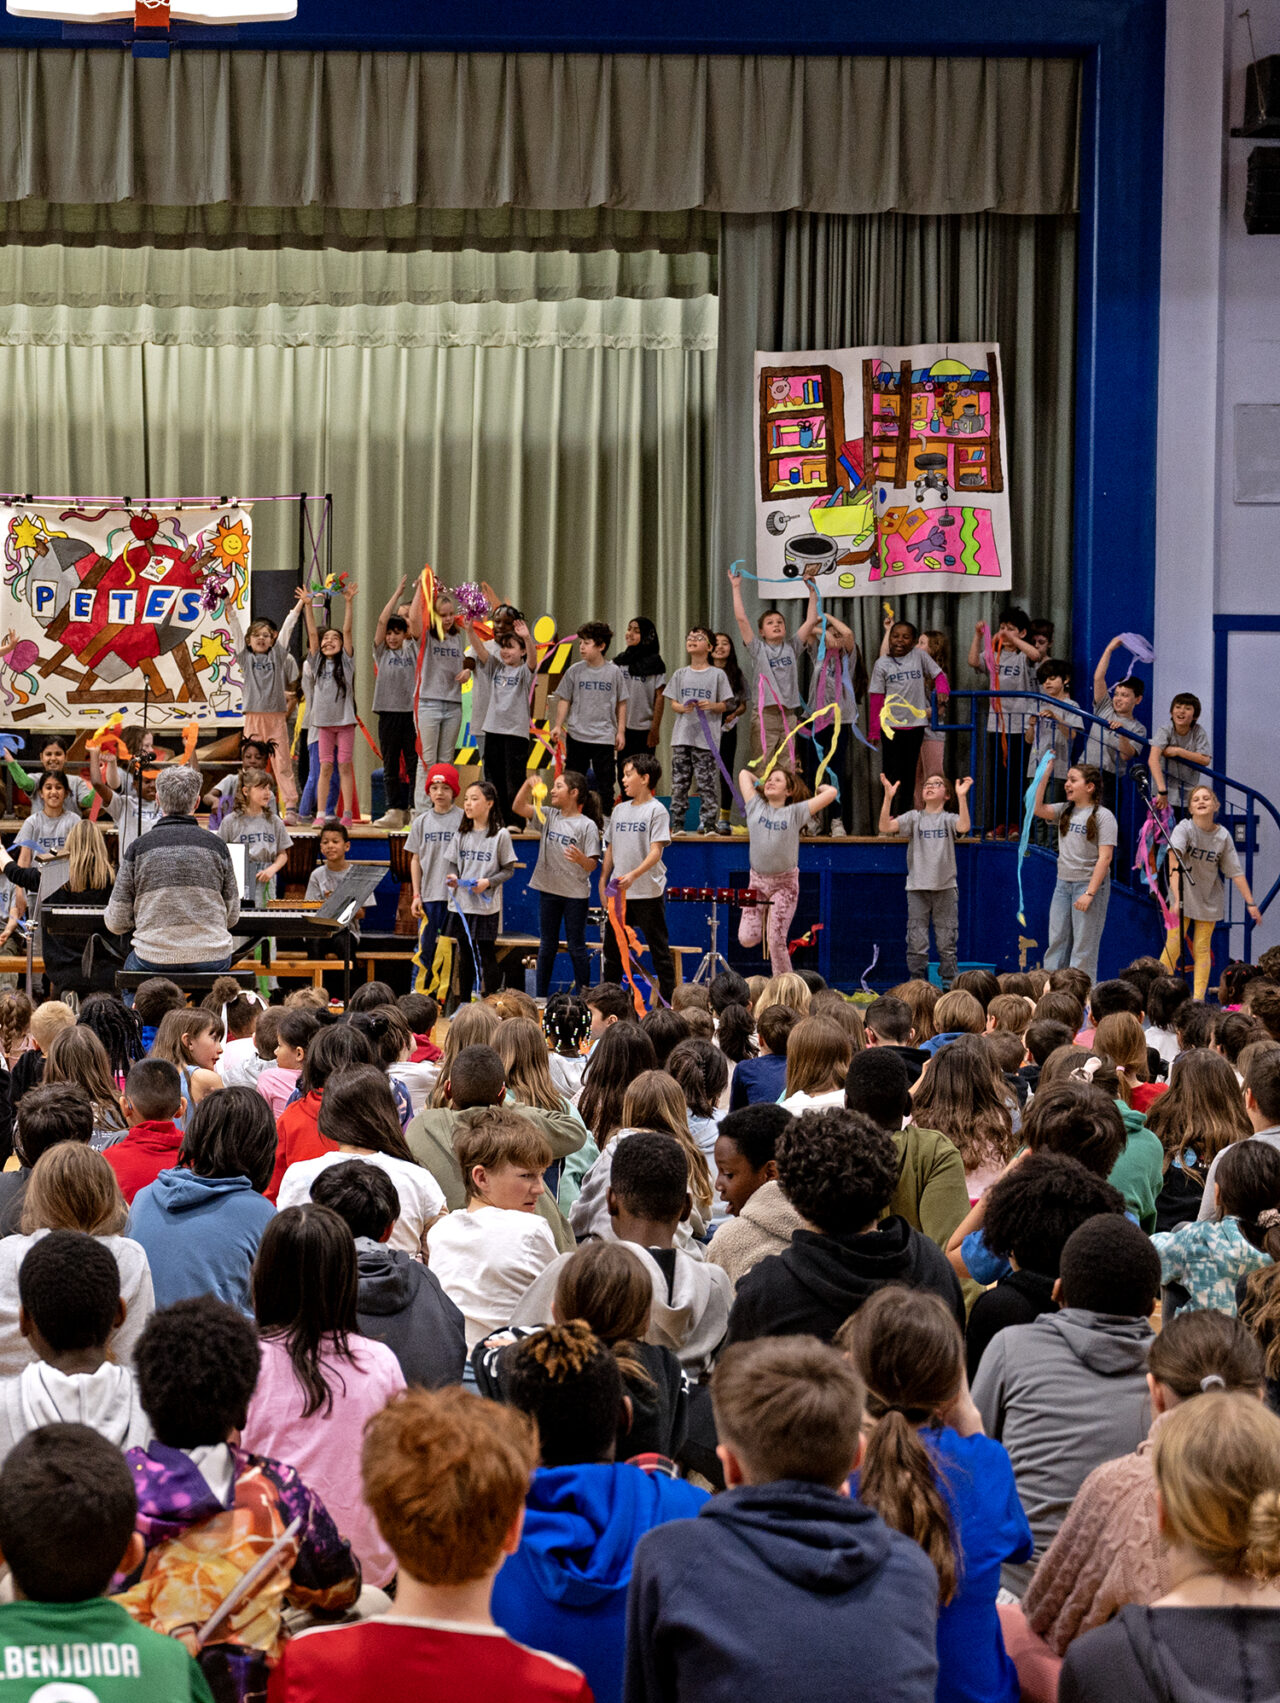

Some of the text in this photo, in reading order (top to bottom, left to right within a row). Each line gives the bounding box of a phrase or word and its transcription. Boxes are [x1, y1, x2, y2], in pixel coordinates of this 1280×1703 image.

[36, 586, 202, 622] PETES
[888, 670, 922, 683] PETES
[579, 681, 612, 692] PETES
[615, 822, 647, 833] PETES
[239, 833, 275, 844] PETES
[460, 850, 492, 862] PETES
